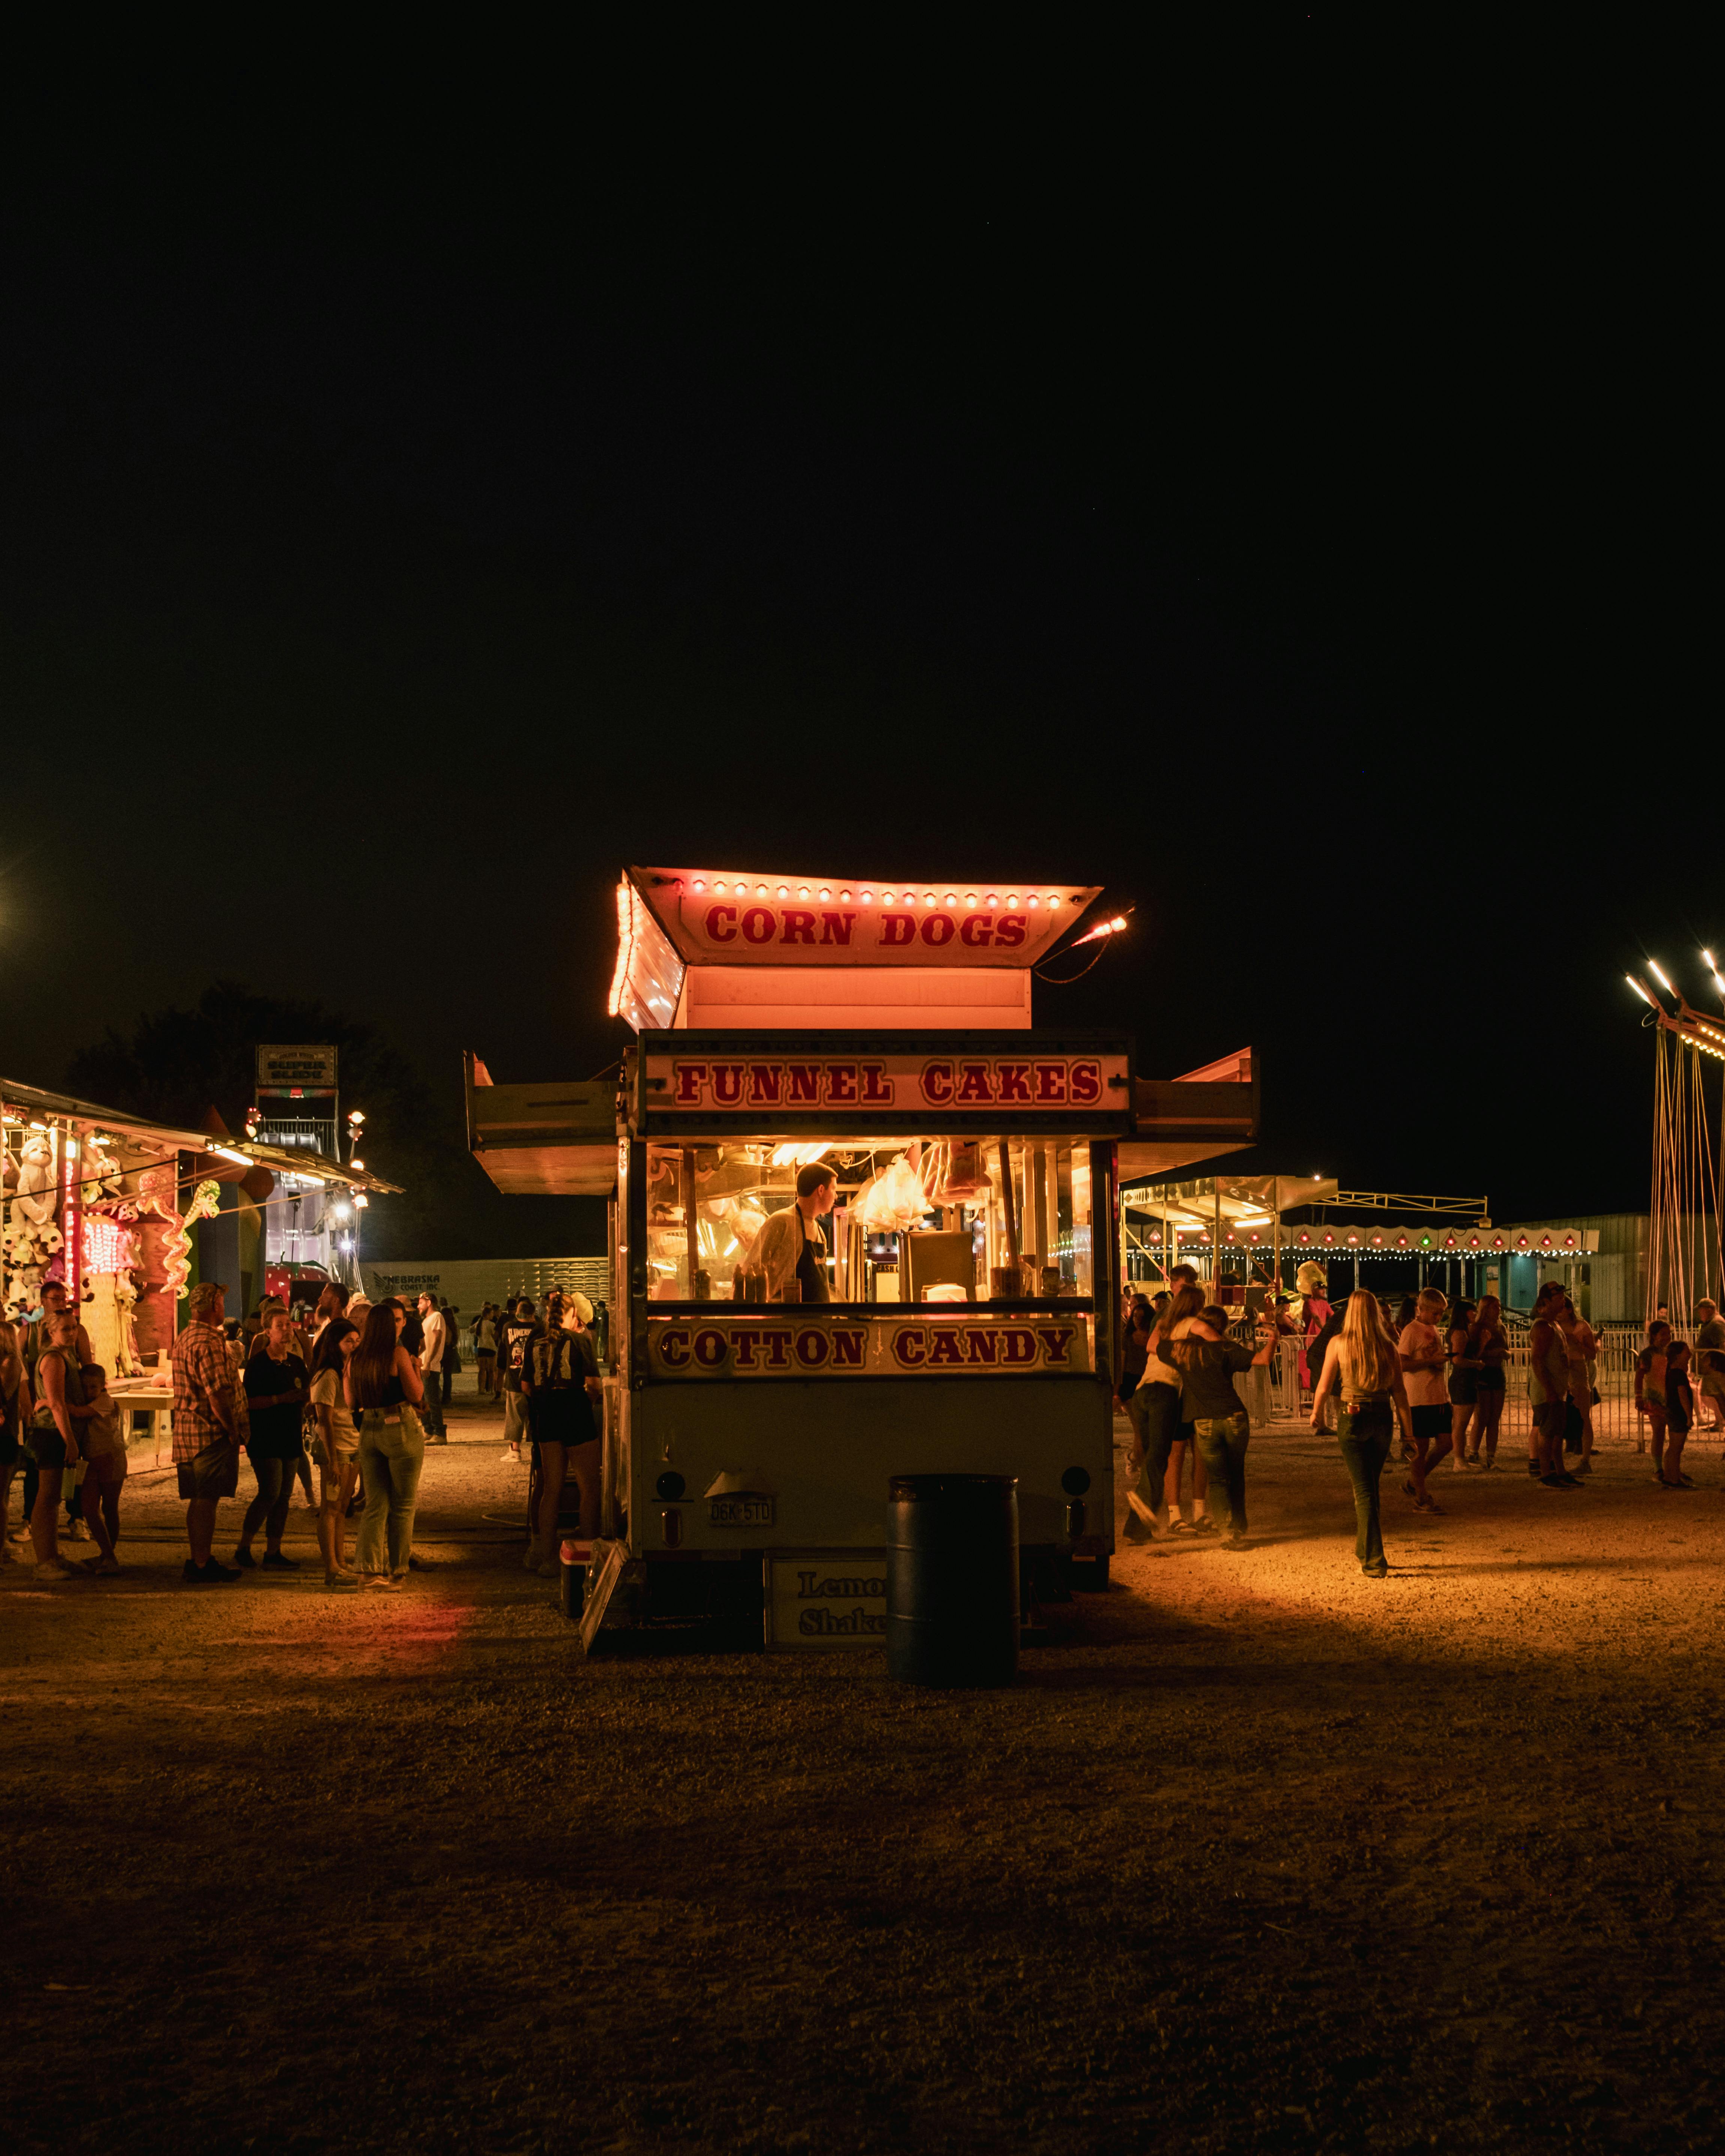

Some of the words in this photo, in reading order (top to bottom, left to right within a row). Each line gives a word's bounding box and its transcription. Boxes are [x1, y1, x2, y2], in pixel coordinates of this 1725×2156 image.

[706, 905, 857, 946] CORN
[879, 912, 1028, 948] DOGS
[676, 1065, 894, 1102] FUNNEL
[923, 1064, 1102, 1101] CAKES
[383, 1275, 440, 1285] NEBRASKA
[661, 1330, 865, 1367] COTTON
[895, 1329, 1075, 1363] CANDY
[797, 1572, 887, 1598] Lemo
